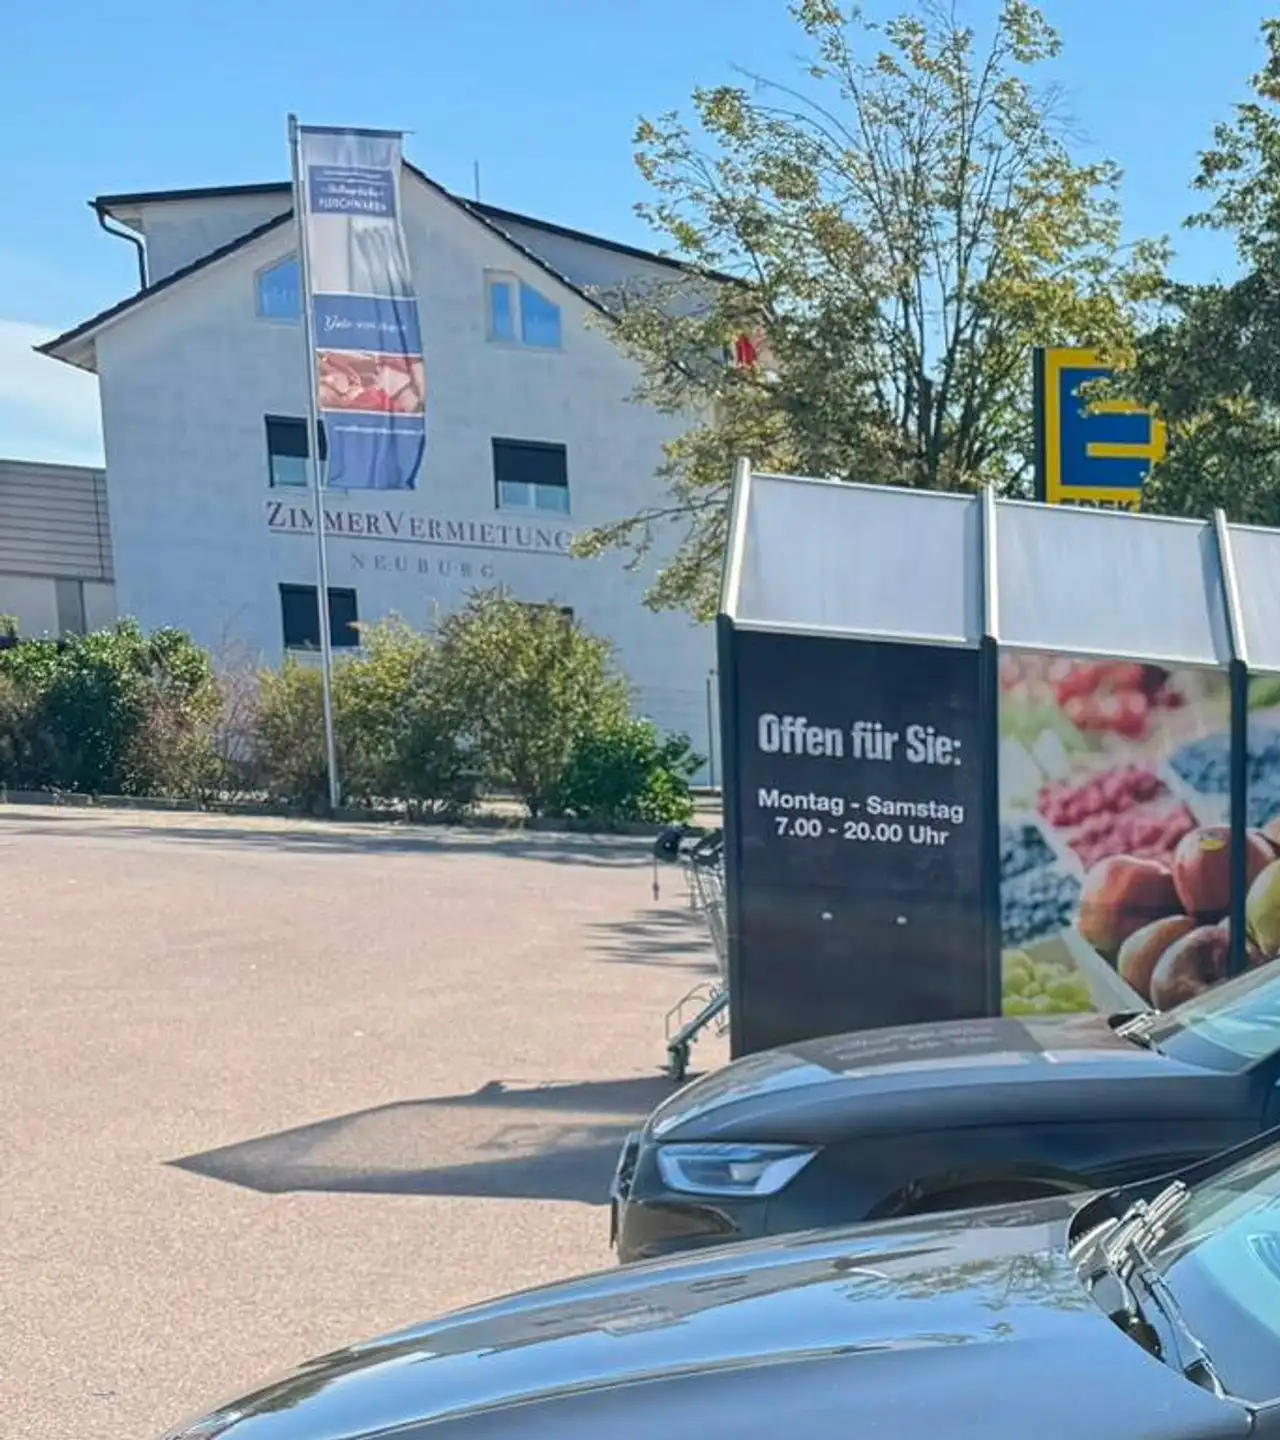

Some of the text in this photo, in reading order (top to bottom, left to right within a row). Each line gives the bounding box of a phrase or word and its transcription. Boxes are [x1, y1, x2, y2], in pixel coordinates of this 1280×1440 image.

[351, 553, 495, 579] NEUBURG
[758, 713, 962, 766] Offen für Sie:
[758, 788, 844, 817] Montag
[866, 795, 964, 824] Samstag
[775, 816, 822, 838] 7.00
[843, 821, 903, 843] 20.00
[909, 825, 950, 846] Uhr
